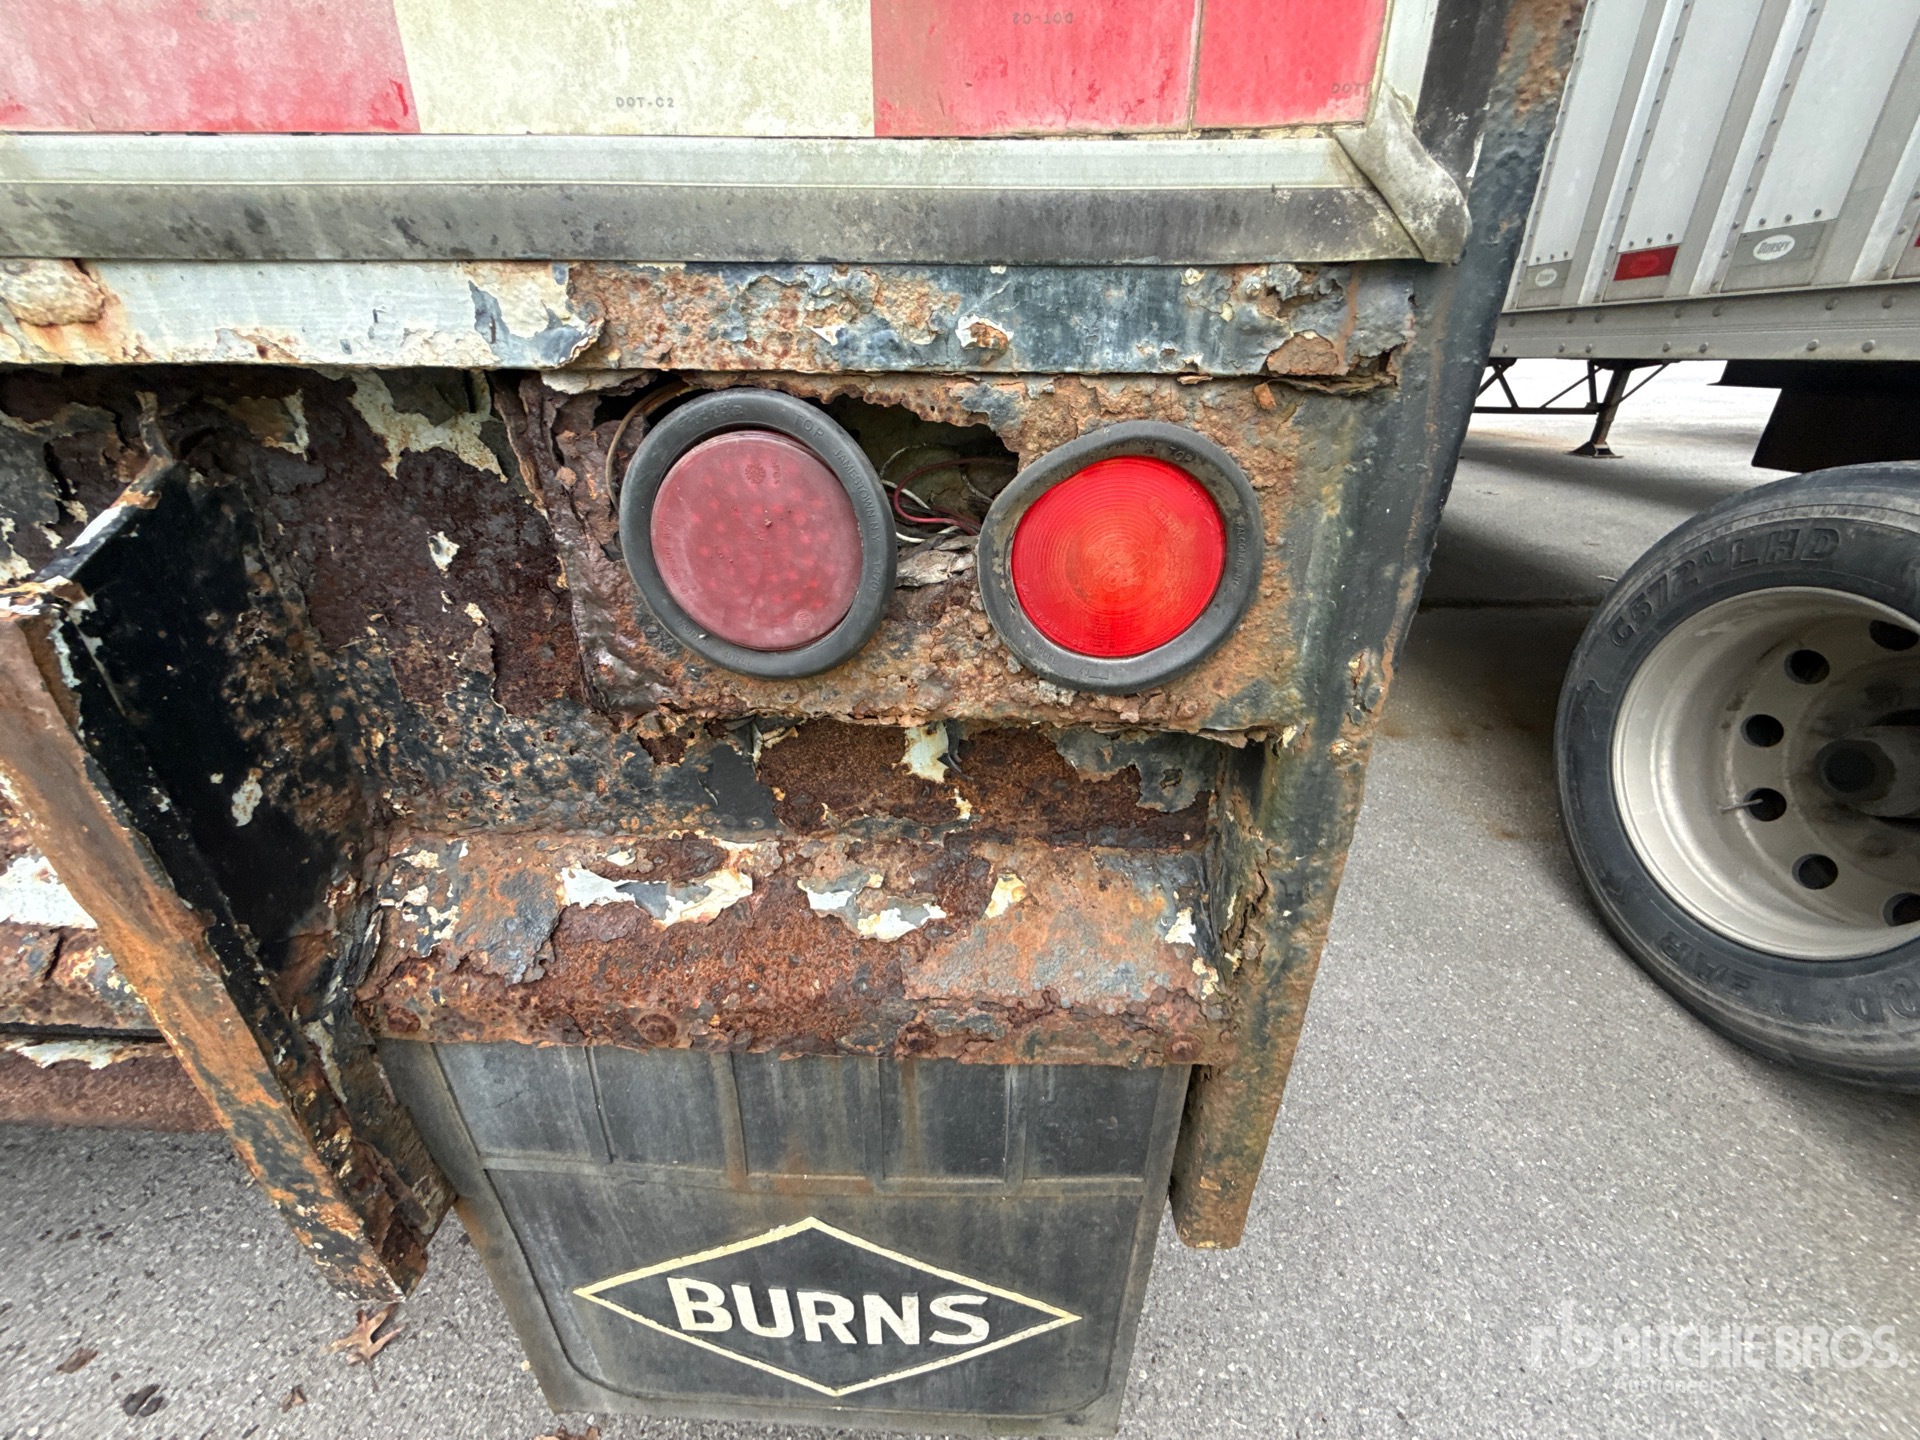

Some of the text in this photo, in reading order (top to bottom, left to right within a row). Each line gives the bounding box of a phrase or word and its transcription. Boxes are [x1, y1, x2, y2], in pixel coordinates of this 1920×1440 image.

[615, 96, 674, 109] DOT-C2
[793, 411, 825, 439] TOP
[832, 448, 876, 519] JAMESTOWN
[1731, 527, 1840, 571] LHD
[667, 1277, 990, 1346] BURNS
